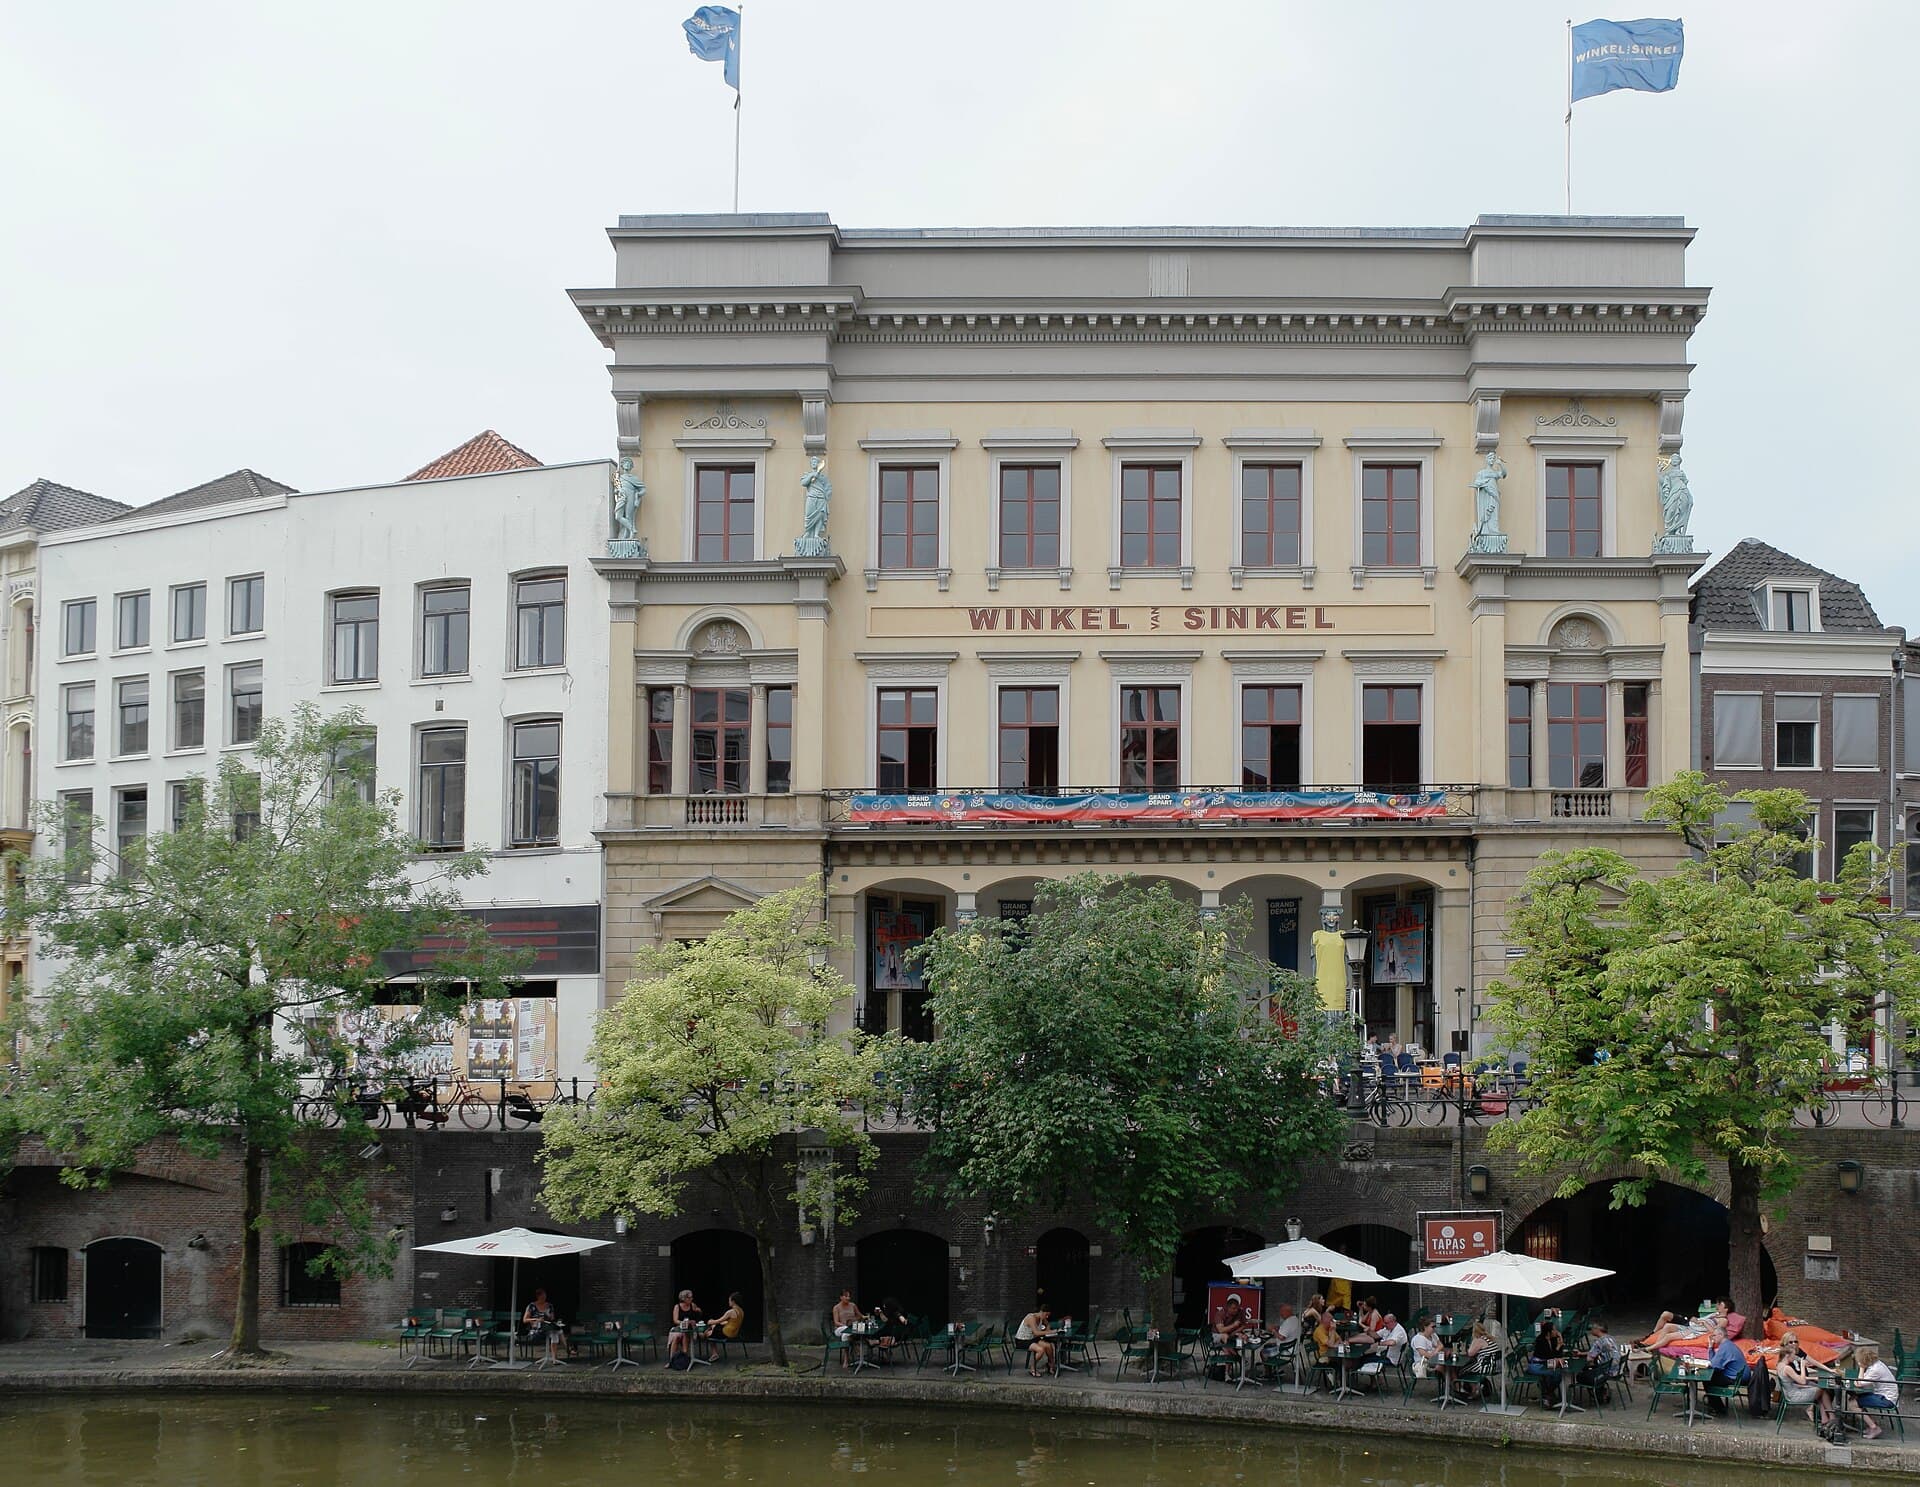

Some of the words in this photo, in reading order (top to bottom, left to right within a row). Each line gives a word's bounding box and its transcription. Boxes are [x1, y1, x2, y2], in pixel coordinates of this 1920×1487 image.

[1576, 44, 1626, 63] WINKEL
[968, 608, 1130, 631] WINKEL
[1150, 608, 1160, 630] VAN
[1183, 607, 1335, 630] SINKEL
[1432, 1238, 1466, 1250] TAPAS
[1528, 1237, 1558, 1249] TAPAS
